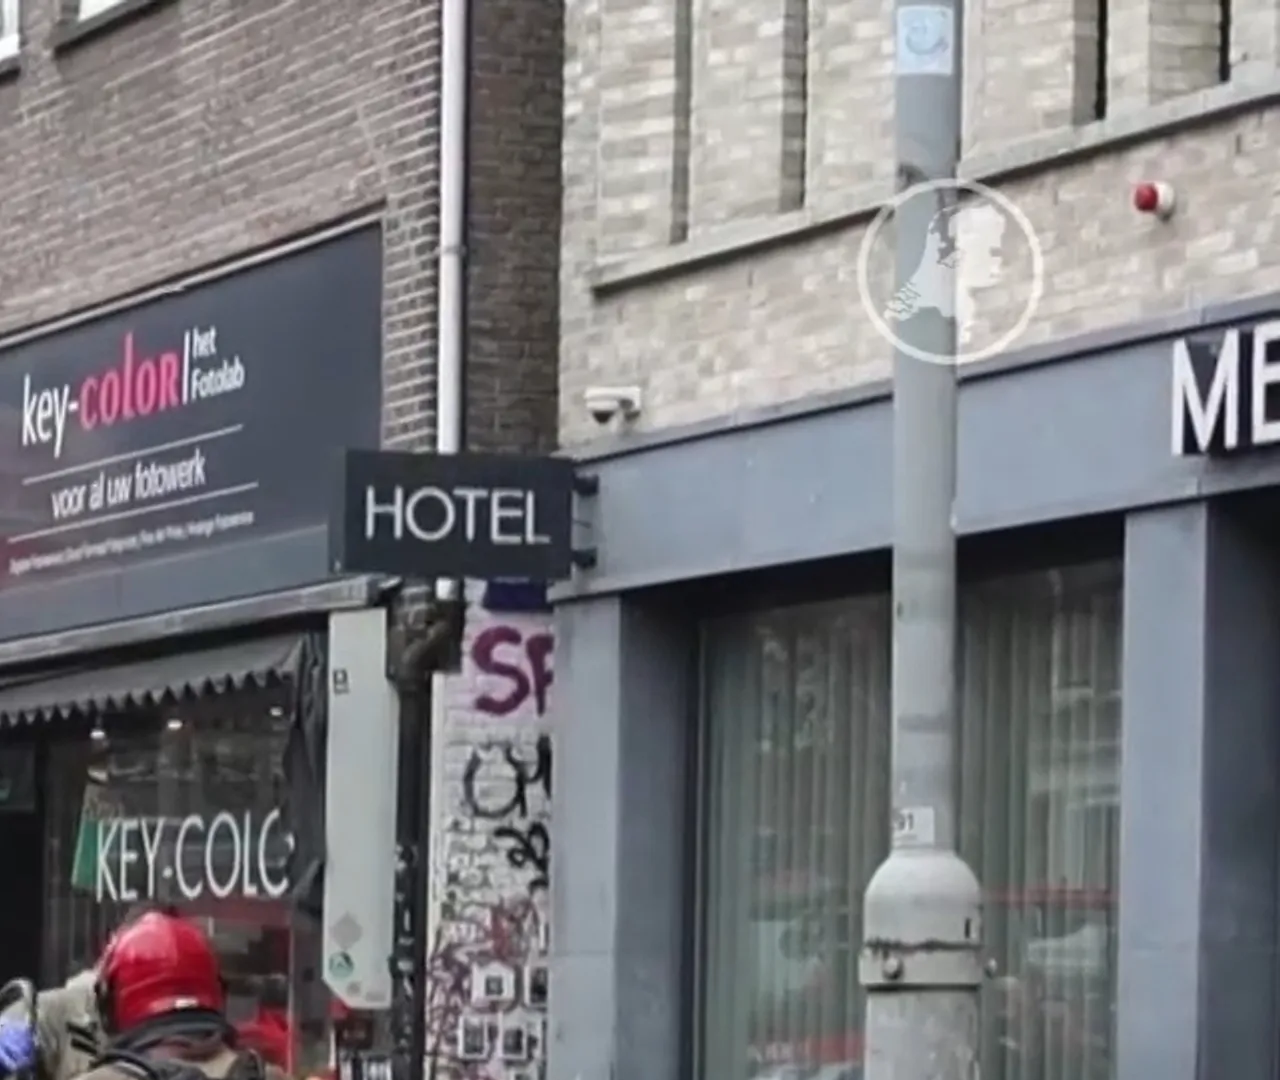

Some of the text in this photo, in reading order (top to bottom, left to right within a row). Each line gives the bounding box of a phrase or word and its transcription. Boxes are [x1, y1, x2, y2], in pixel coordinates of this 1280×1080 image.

[192, 325, 217, 359] het
[191, 355, 246, 402] Fotolab
[1171, 320, 1280, 456] ME
[51, 447, 206, 519] voor al uw fotowerk
[365, 485, 551, 545] HOTEL
